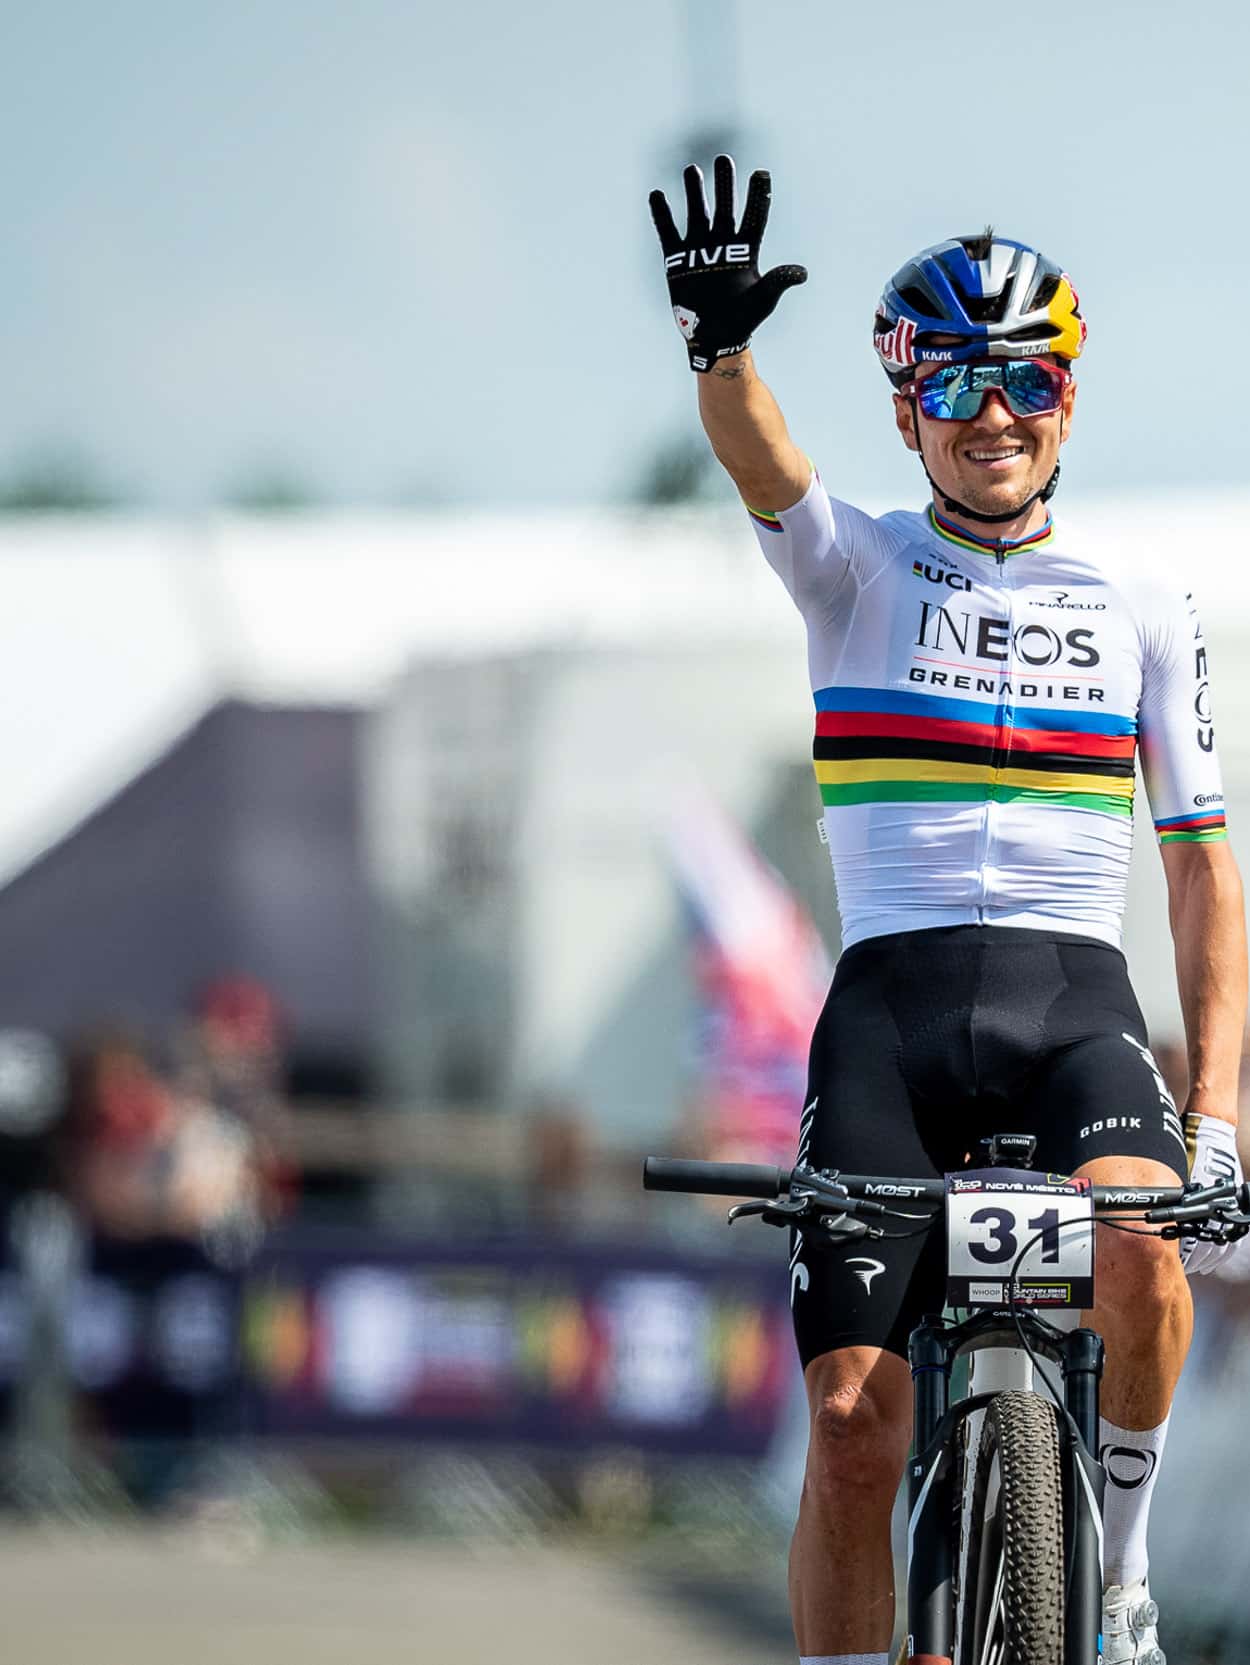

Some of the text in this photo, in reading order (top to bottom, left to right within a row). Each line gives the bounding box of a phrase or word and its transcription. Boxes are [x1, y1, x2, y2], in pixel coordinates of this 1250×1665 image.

[665, 243, 750, 268] FIVE
[922, 351, 953, 361] KASK
[924, 565, 972, 592] UCI
[914, 600, 1100, 668] INEOS
[909, 667, 1104, 702] GRENADIER
[1079, 1116, 1141, 1138] GOBIK
[1001, 1138, 1030, 1146] GARMIN
[968, 1207, 1060, 1264] 31
[972, 1288, 1000, 1297] WHOOP
